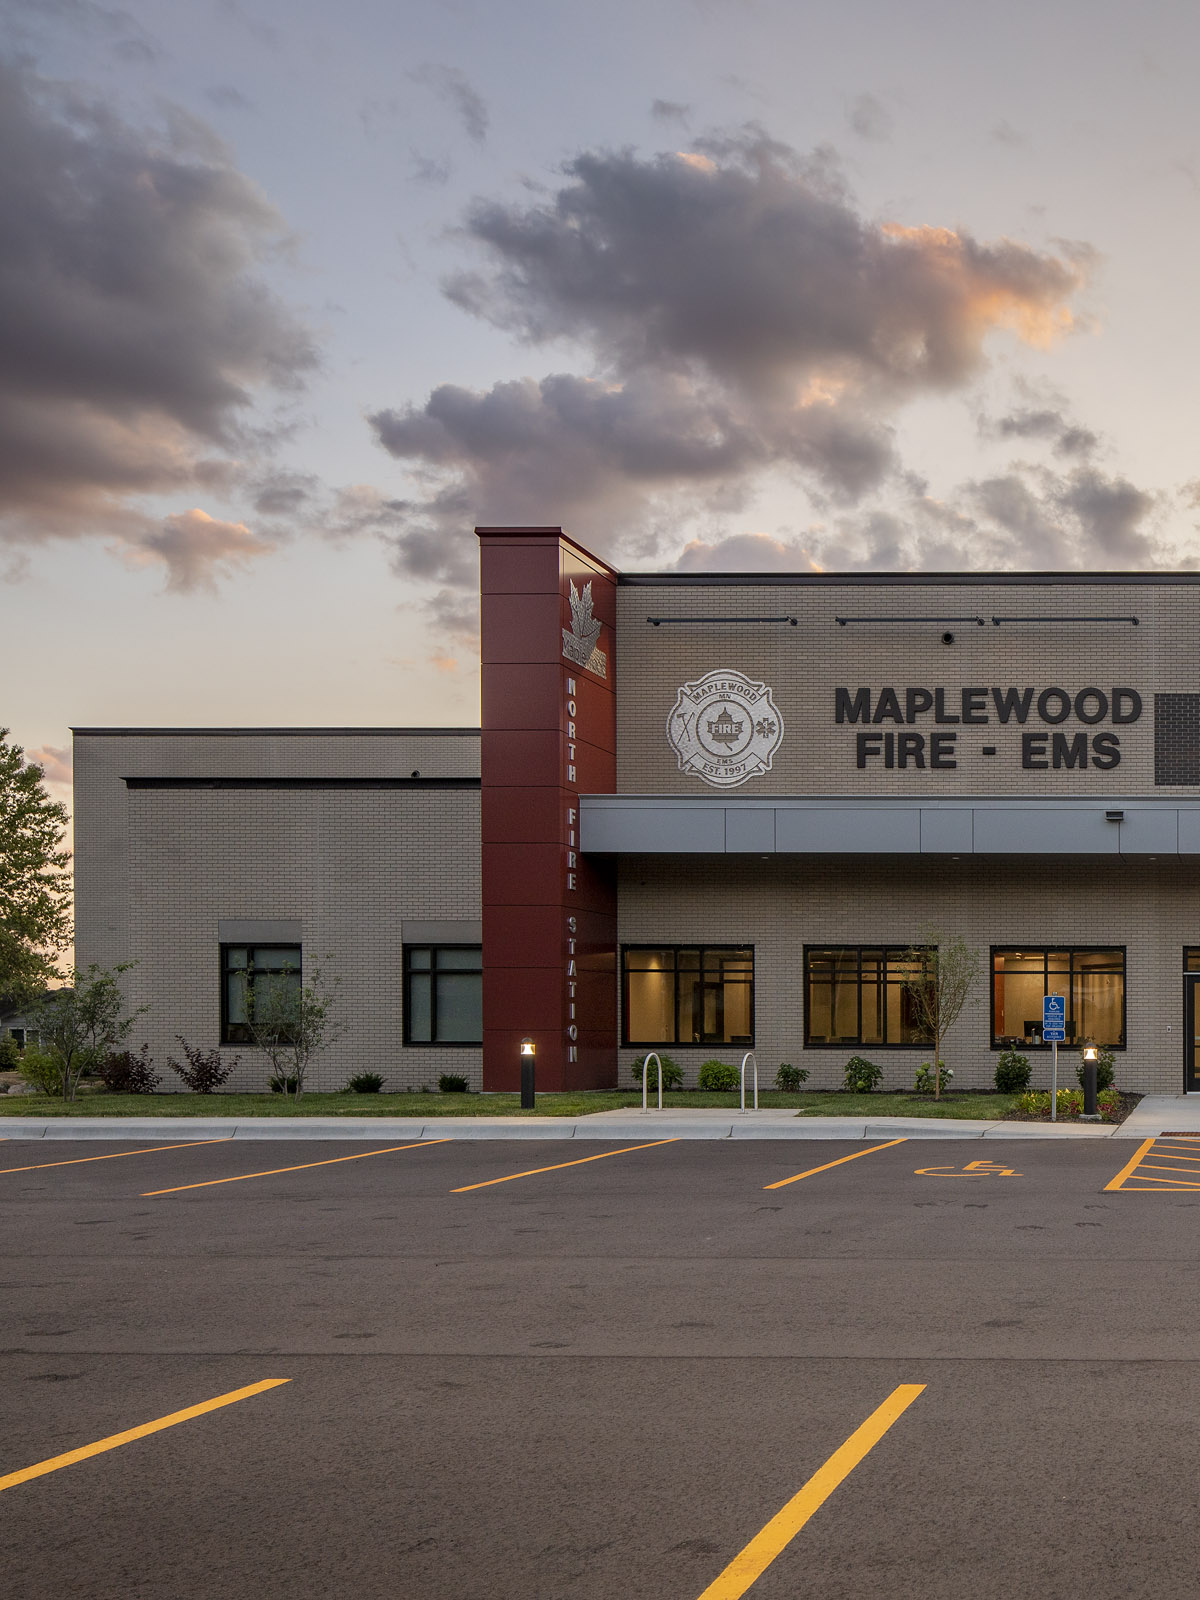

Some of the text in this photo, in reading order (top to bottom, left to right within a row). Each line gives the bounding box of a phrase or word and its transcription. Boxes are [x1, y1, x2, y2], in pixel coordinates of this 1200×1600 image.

[692, 682, 757, 702] MAPLEWOOD
[834, 687, 1143, 724] MAPLEWOOD
[711, 724, 740, 734] FIRE
[856, 732, 957, 769] FIRE
[1022, 732, 1121, 769] EMS
[702, 763, 747, 775] EST. 1997
[567, 677, 578, 1063] NORTH FIRE STATION
